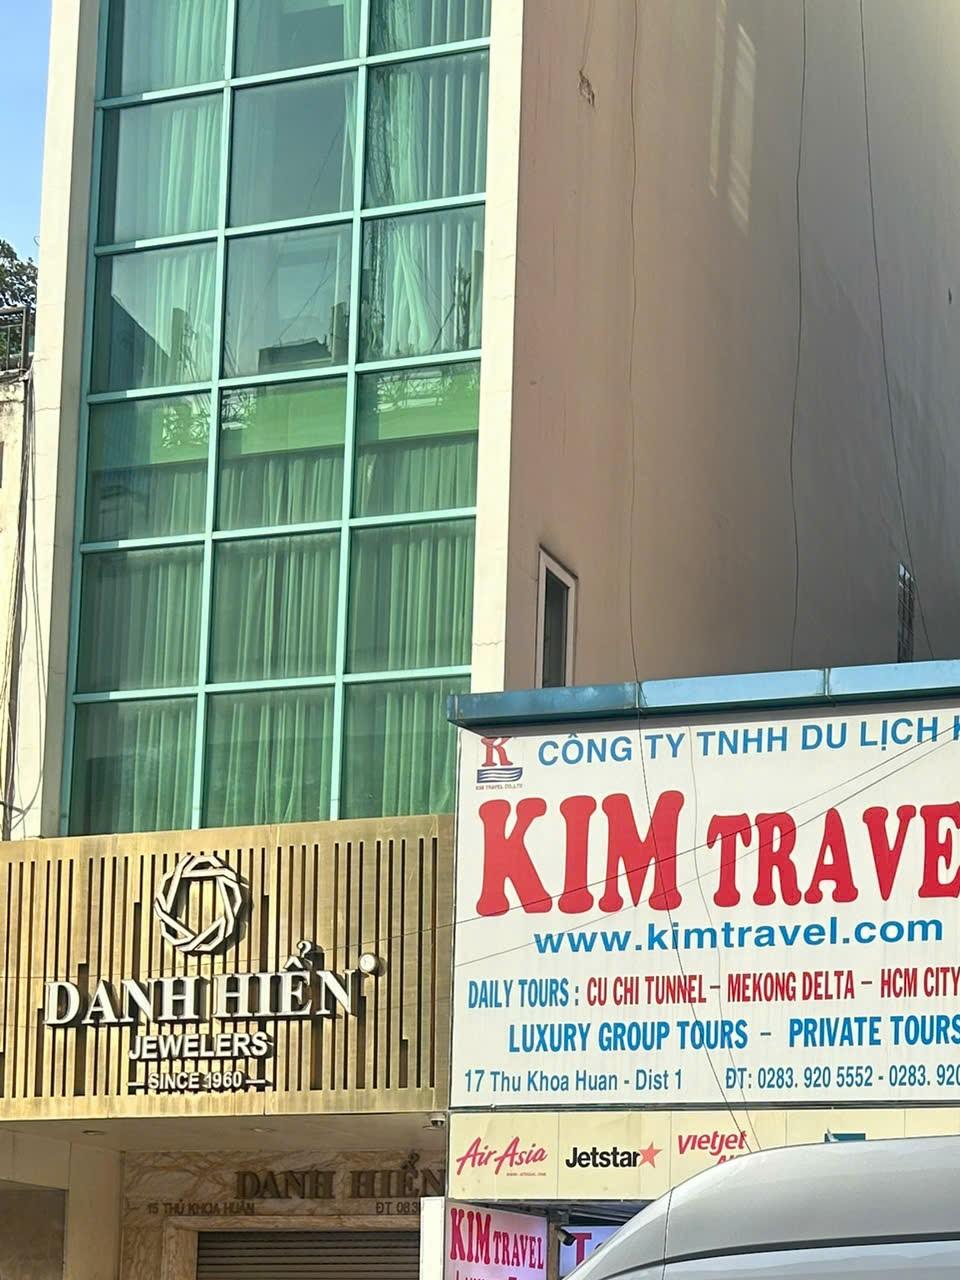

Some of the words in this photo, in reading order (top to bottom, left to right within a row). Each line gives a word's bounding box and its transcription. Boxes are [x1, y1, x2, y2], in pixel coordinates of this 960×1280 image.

[481, 736, 514, 767] K
[538, 733, 632, 766] CÔNG
[641, 733, 685, 760] TY
[697, 726, 788, 756] TNHH
[802, 723, 847, 751] DU
[860, 717, 938, 752] LỊCH
[476, 790, 684, 917] KIM
[534, 916, 943, 954] www.kimtravel.com
[44, 974, 200, 1027] DANH
[213, 940, 355, 1018] HIỂN
[468, 979, 514, 1008] DAILY
[519, 977, 569, 1007] TOURS
[586, 979, 609, 1006] CU
[612, 978, 640, 1005] CHI
[645, 974, 707, 1004] TUNNEL
[727, 972, 796, 1002] MEKONG
[801, 970, 855, 1000] DELTA
[880, 967, 918, 998] HCM
[129, 1031, 268, 1060] JEWELERS
[508, 1022, 590, 1053] LUXURY
[598, 1022, 669, 1052] GROUP
[676, 1019, 748, 1050] TOURS
[788, 1016, 882, 1048] PRIVATE
[149, 1073, 200, 1090] SINCE
[204, 1072, 242, 1088] 1960
[465, 1069, 485, 1093] 17
[491, 1070, 521, 1093] Thu
[526, 1069, 571, 1093] Khoa
[574, 1069, 619, 1092] Huan
[635, 1068, 669, 1091] Dist
[674, 1069, 681, 1090] 1
[725, 1067, 753, 1090] ĐT:
[757, 1066, 799, 1089] 0283.
[803, 1065, 831, 1088] 920
[835, 1065, 873, 1088] 5552
[888, 1064, 931, 1087] 0283.
[565, 1145, 640, 1170] Jetstar
[234, 1170, 337, 1200] DANH
[376, 1202, 393, 1214] ĐT
[396, 1201, 418, 1214] 083
[450, 1208, 491, 1265] KIM
[493, 1231, 544, 1270] TRAVEL
